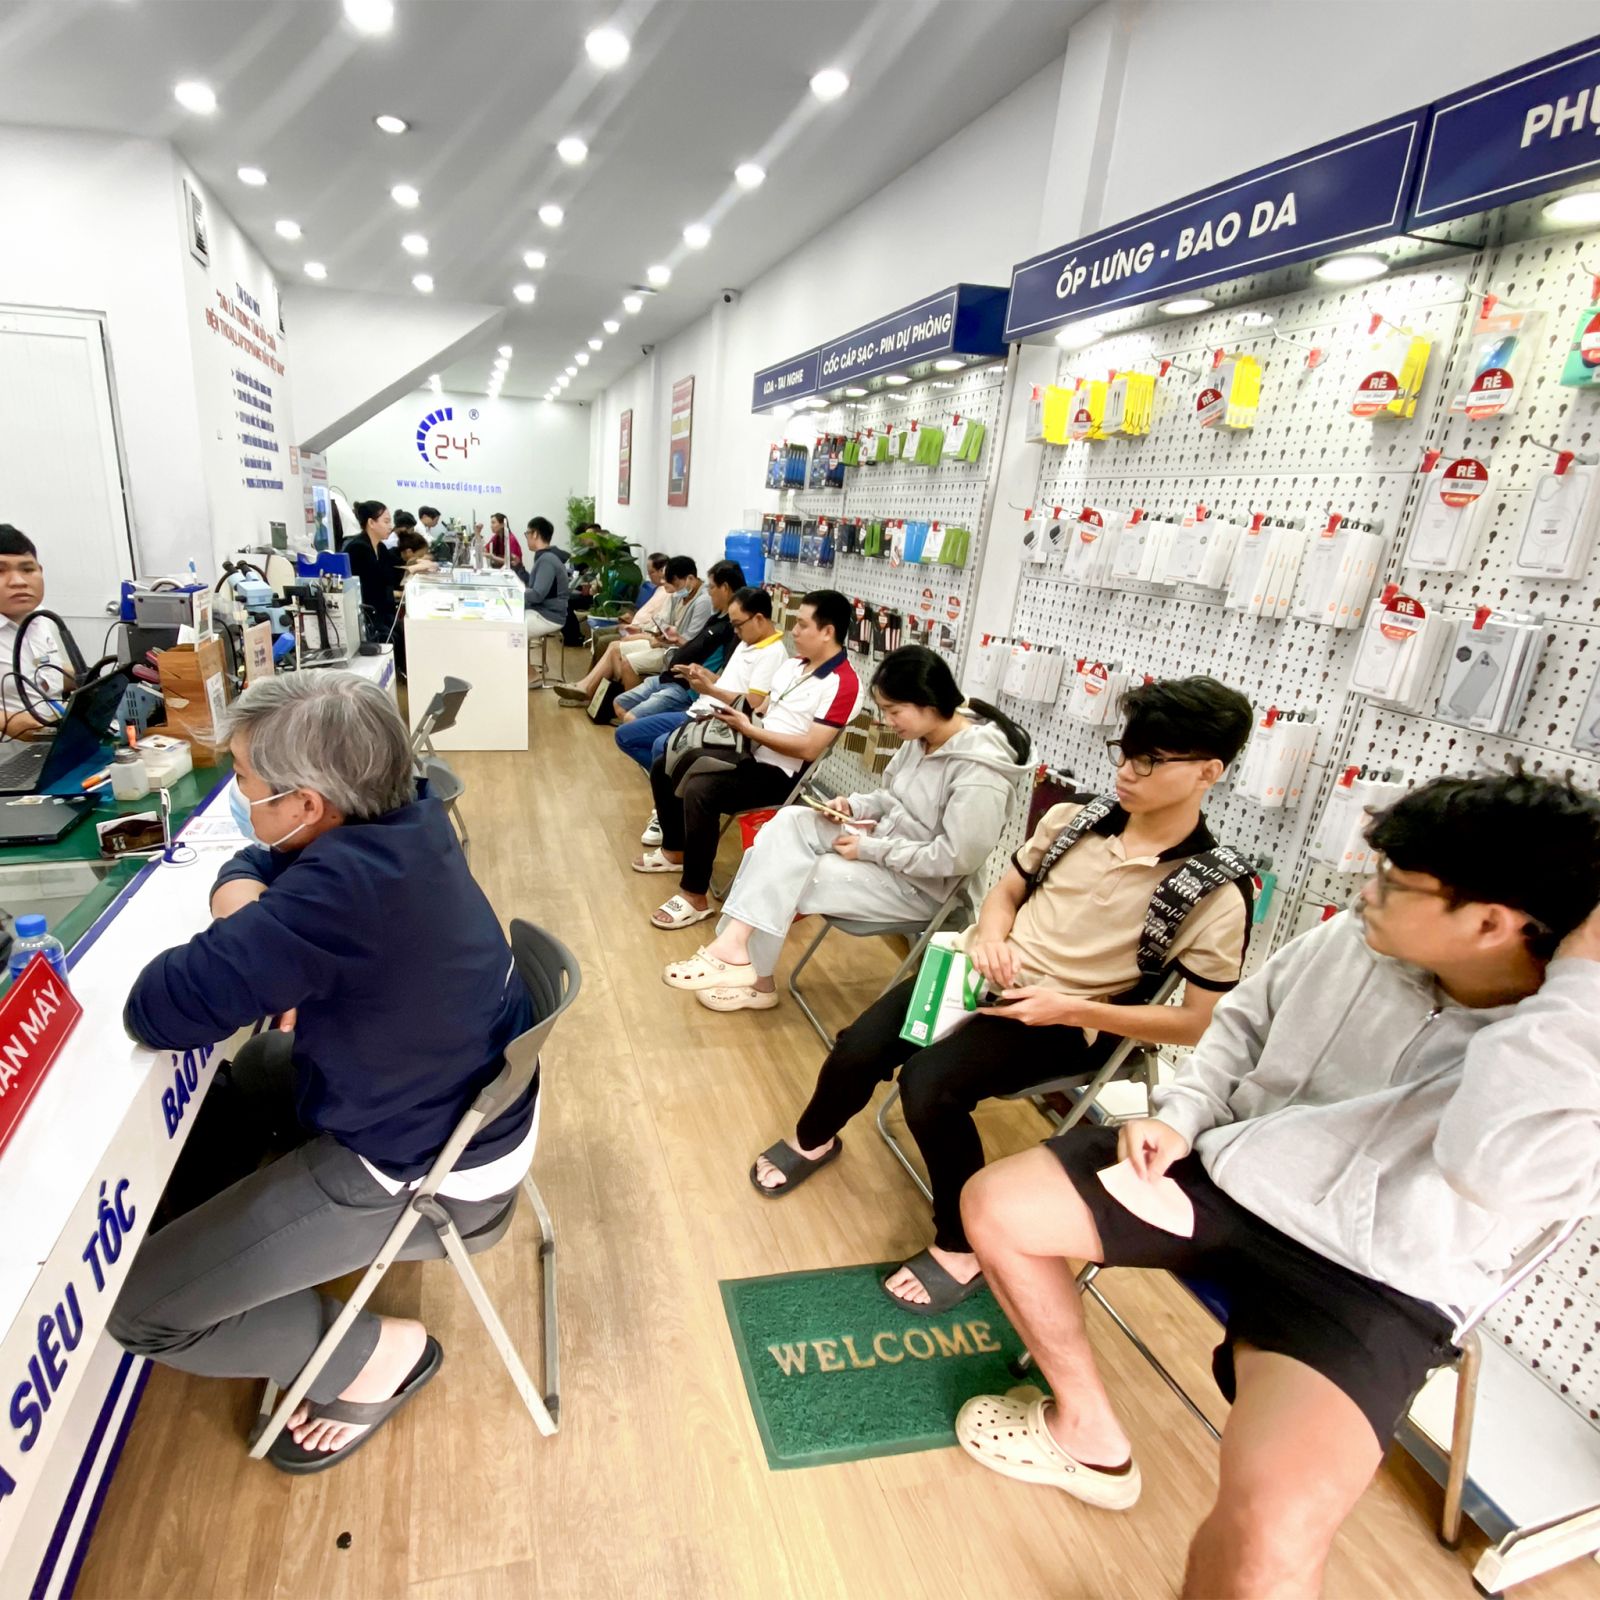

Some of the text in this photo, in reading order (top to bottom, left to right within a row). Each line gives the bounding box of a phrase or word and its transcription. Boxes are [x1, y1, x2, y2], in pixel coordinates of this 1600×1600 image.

[1056, 257, 1086, 299] ỐP
[1090, 242, 1155, 288] LƯNG
[1176, 212, 1242, 262] BAO
[1248, 192, 1297, 238] DA
[787, 368, 804, 387] NGHE
[823, 351, 840, 376] CỐC
[840, 346, 857, 369] CÁP
[857, 342, 875, 366] SẠC
[880, 334, 895, 356] PIN
[896, 325, 911, 351] DỰ
[911, 313, 952, 344] PHÒNG
[0, 979, 61, 1097] ẠN MÁY
[9, 1178, 136, 1453] SIÊU TỐC
[767, 1320, 1002, 1377] WELCOME
